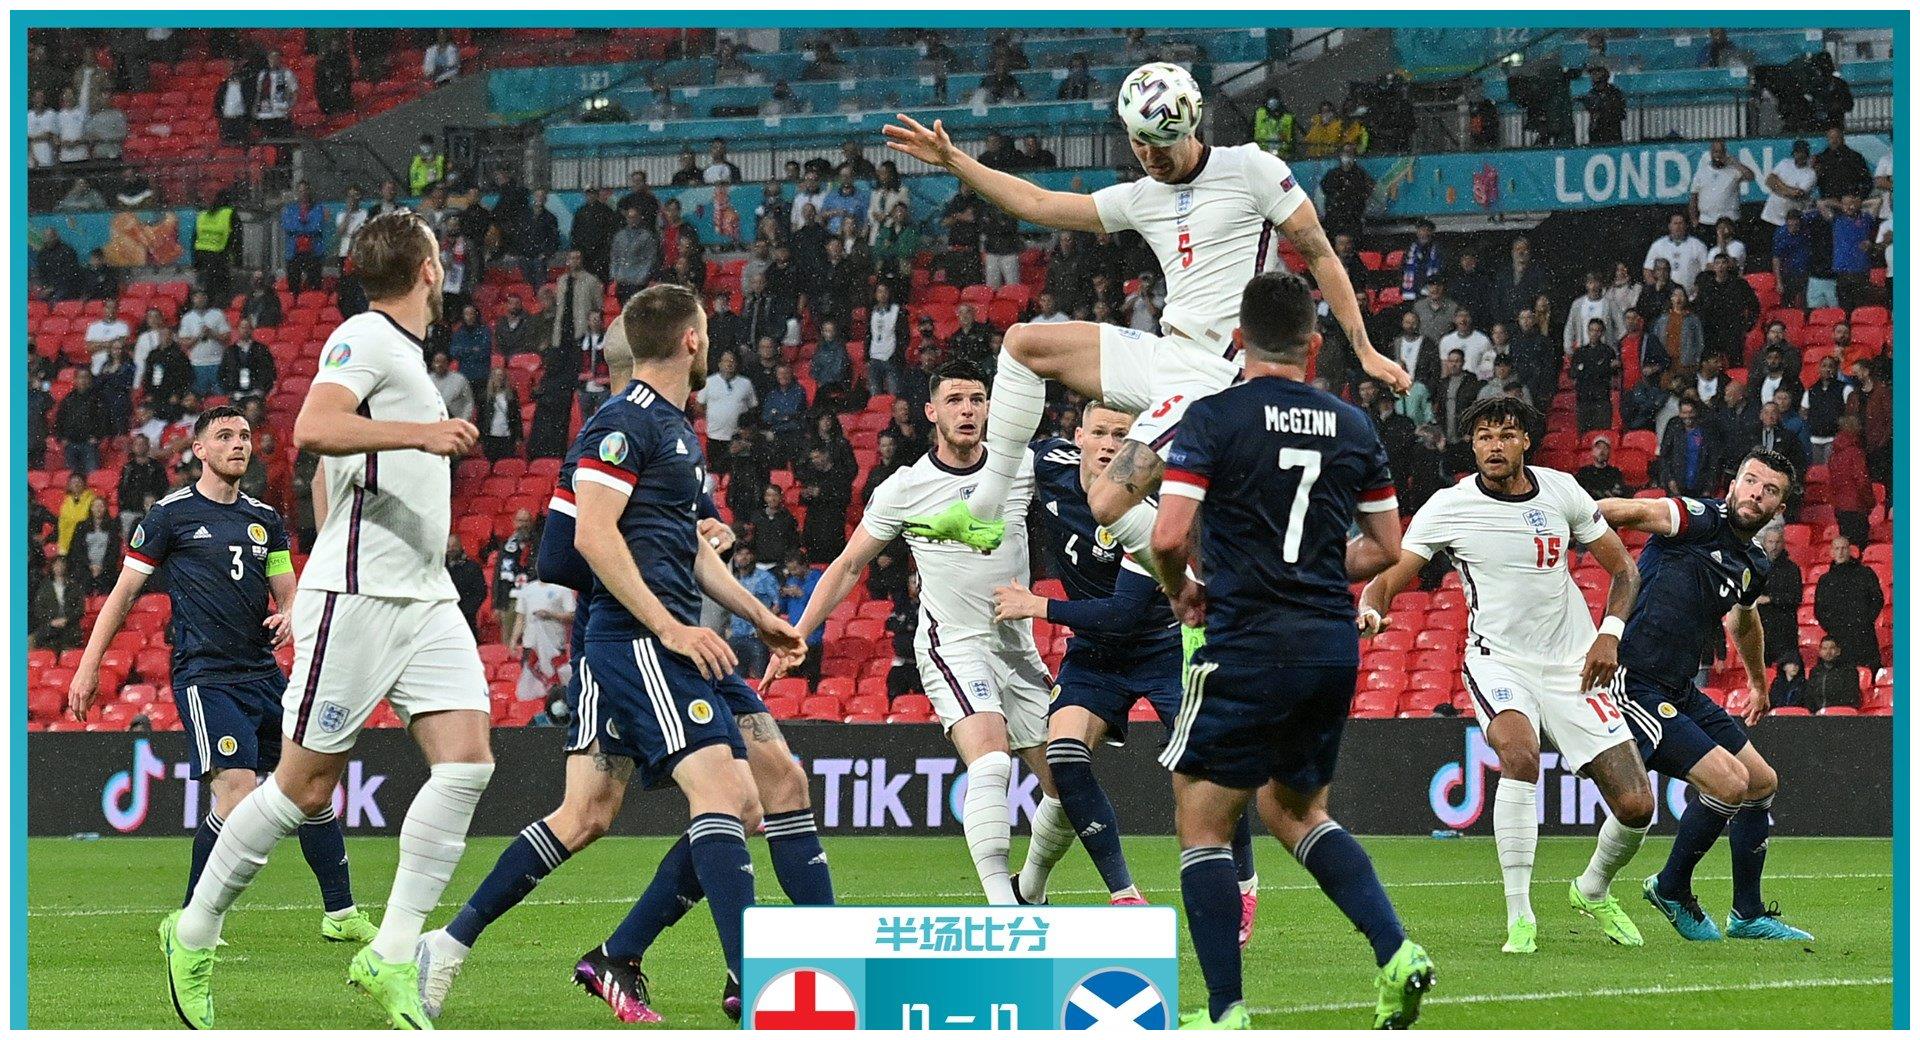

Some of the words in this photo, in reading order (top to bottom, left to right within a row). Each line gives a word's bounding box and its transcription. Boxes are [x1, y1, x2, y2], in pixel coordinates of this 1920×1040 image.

[1555, 147, 1774, 203] LONDN
[1178, 233, 1193, 269] 5
[1152, 394, 1184, 418] 5
[1264, 404, 1337, 438] McGINN
[1278, 446, 1322, 564] 7
[228, 545, 245, 581] 3
[1533, 536, 1561, 568] 15
[1585, 692, 1621, 724] 15
[812, 757, 1040, 828] TikTk
